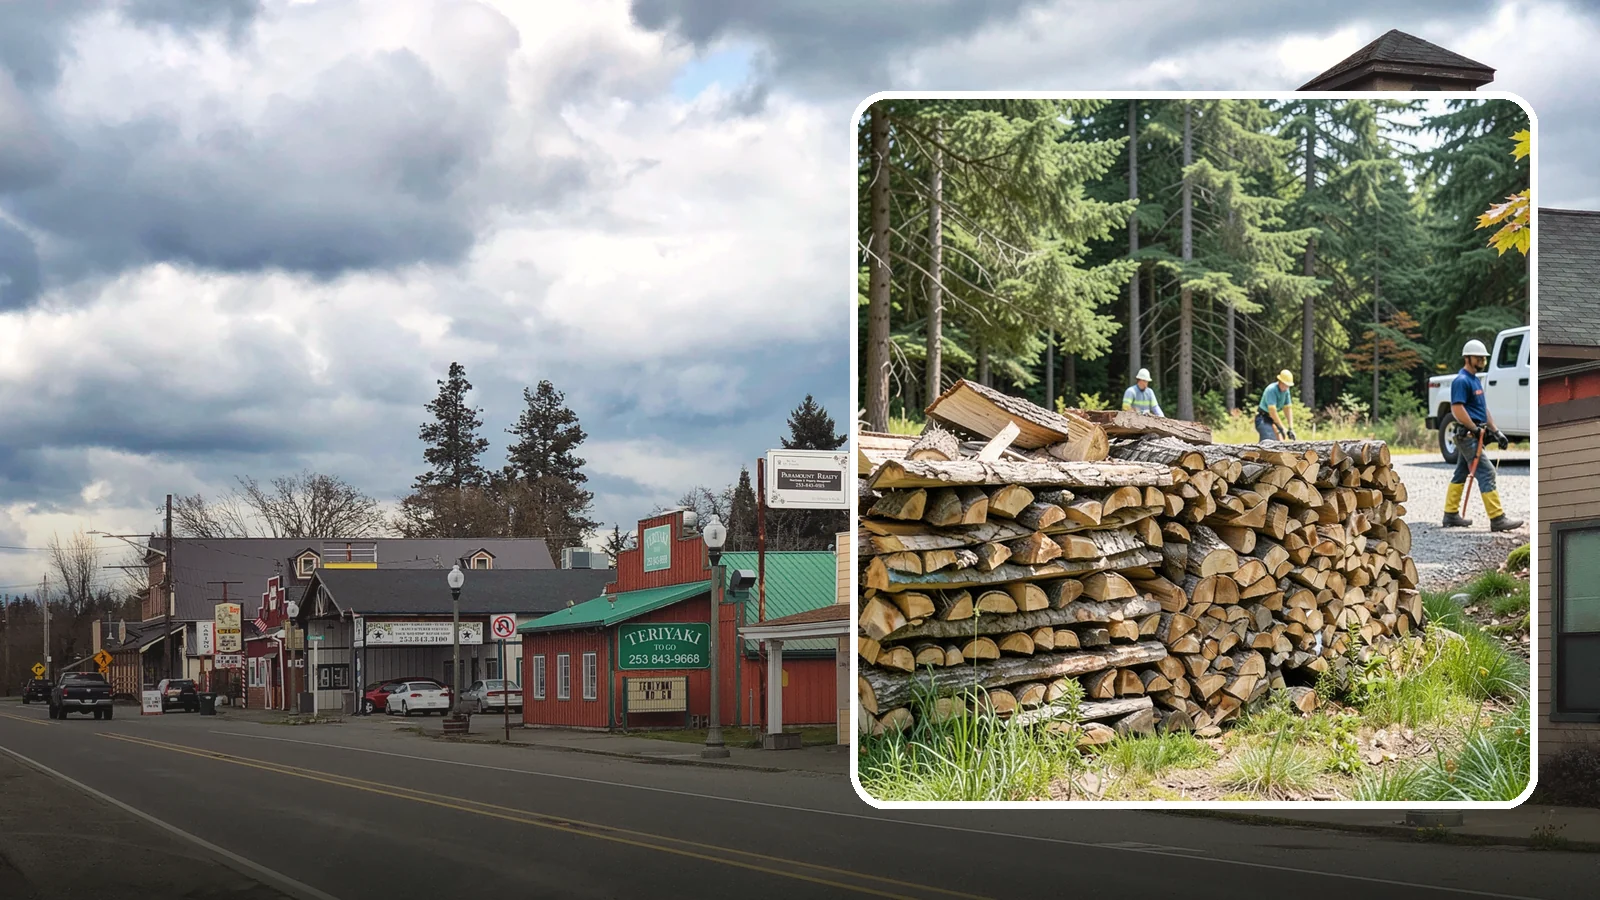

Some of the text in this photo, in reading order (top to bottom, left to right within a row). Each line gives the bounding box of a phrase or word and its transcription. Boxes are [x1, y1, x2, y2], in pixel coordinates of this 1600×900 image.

[817, 472, 838, 480] REALTY
[625, 627, 702, 646] TERIYAKI
[629, 653, 700, 664] 253 843-9668
[639, 681, 672, 691] TERIYAKI
